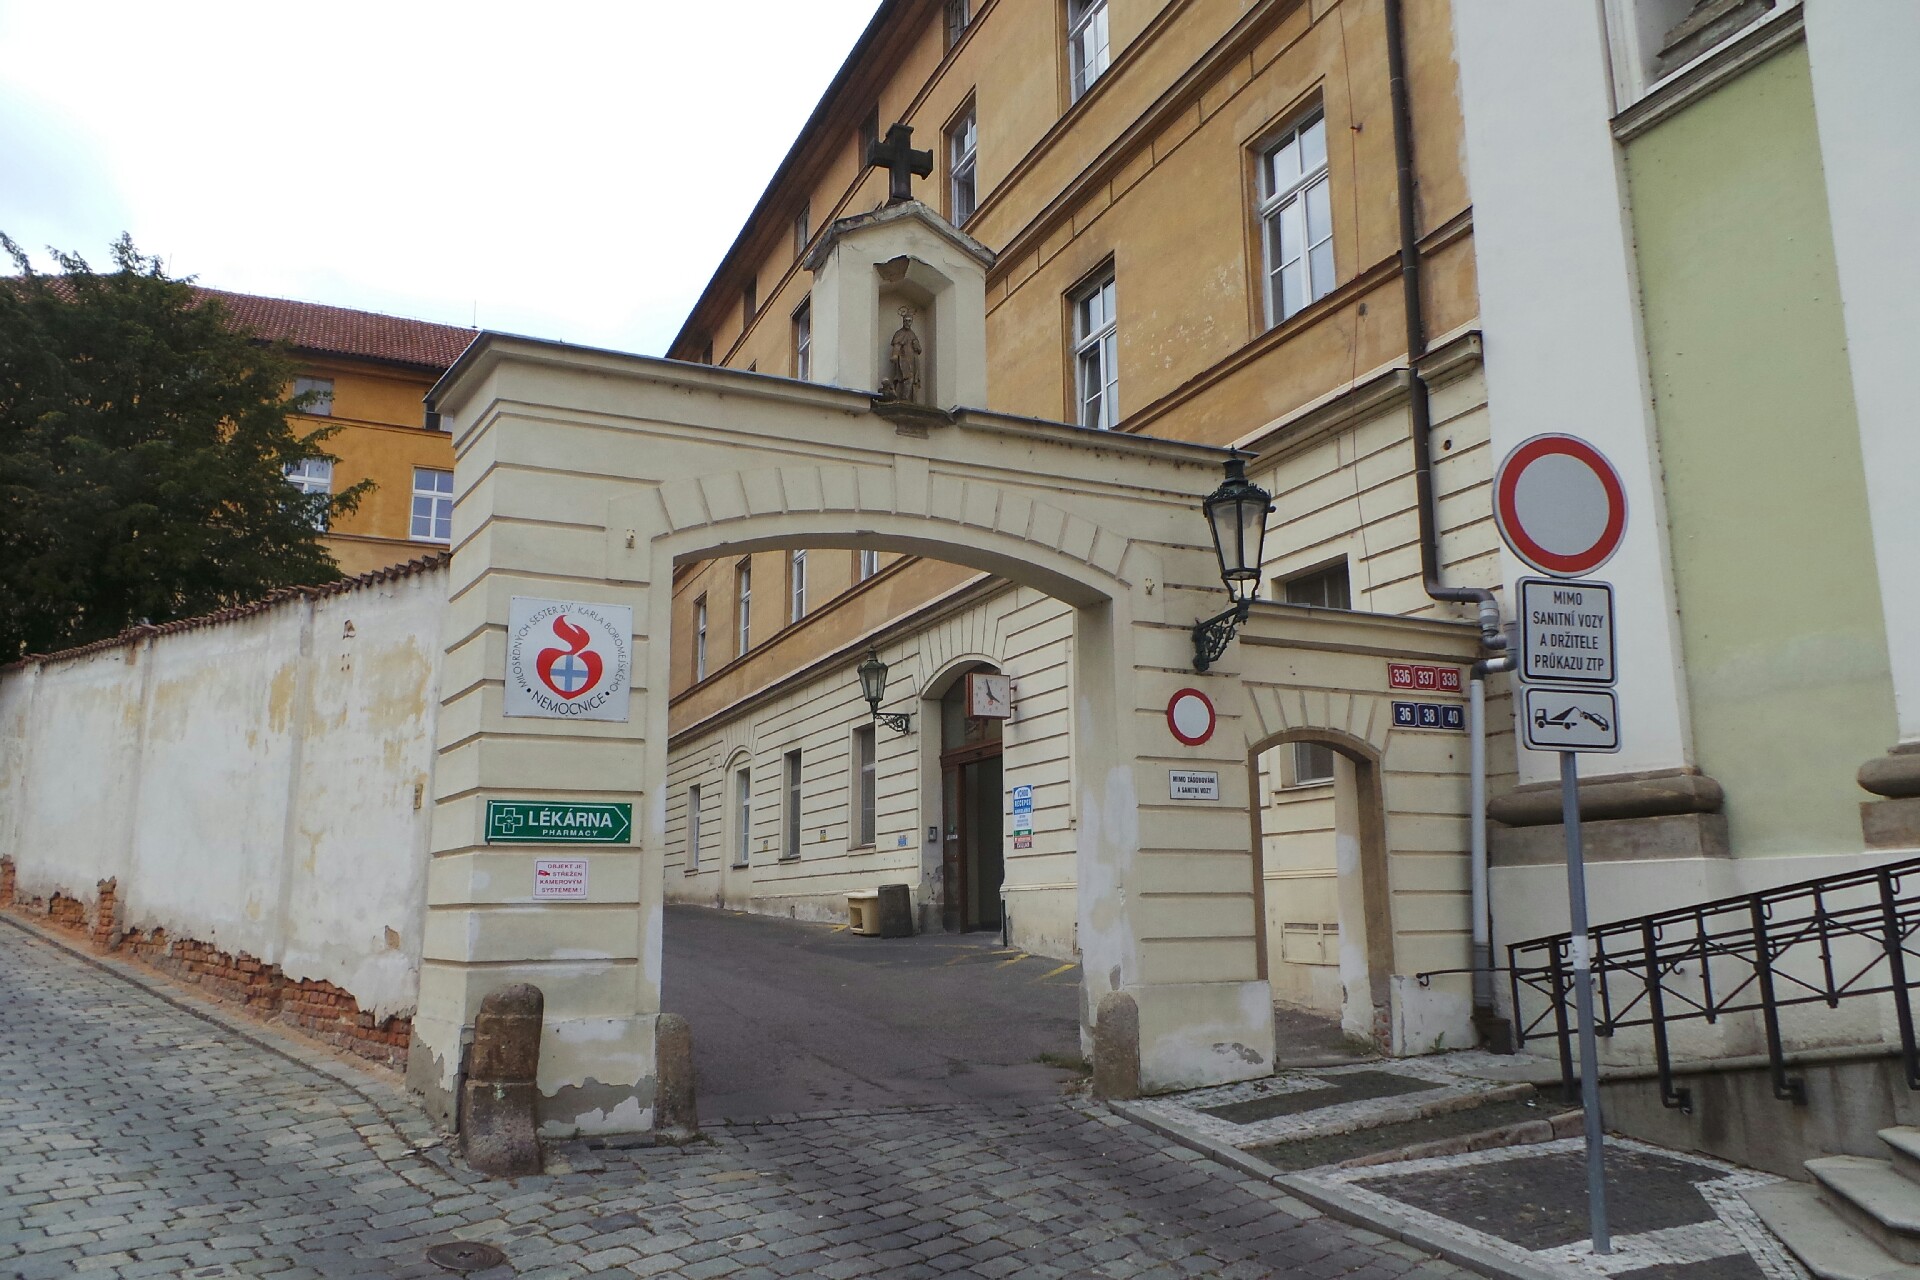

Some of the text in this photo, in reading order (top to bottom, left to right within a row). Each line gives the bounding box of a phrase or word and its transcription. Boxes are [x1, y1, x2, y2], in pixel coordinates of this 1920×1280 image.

[1553, 591, 1582, 606] MIMO
[529, 606, 558, 626] SESTER
[578, 607, 604, 624] KARLA
[1533, 610, 1604, 628] SANITNÍ VOZY
[1540, 631, 1598, 649] A DRŽITELE
[1534, 653, 1604, 671] PRŮKAZU ZTP
[1393, 669, 1458, 686] 336 337 338
[531, 690, 606, 715] NEMOCNICE
[1400, 707, 1459, 724] 36 38 40
[528, 808, 613, 828] LÉKÁRNA
[542, 829, 598, 837] PHARMACY
